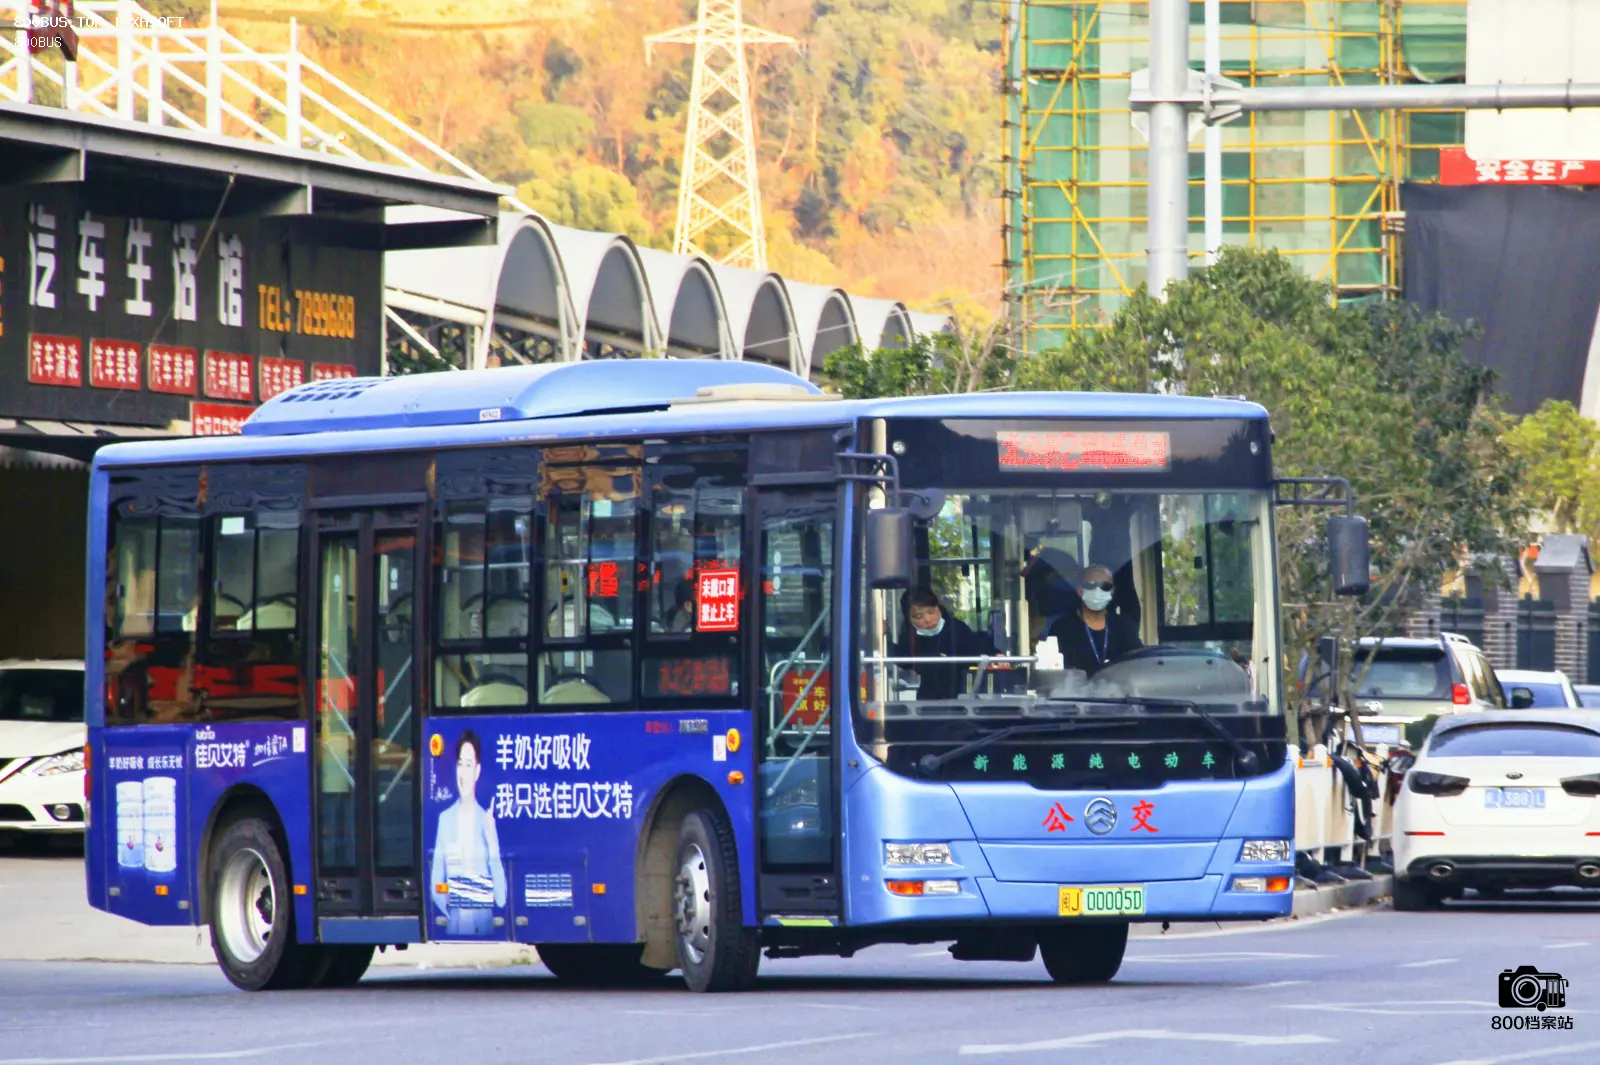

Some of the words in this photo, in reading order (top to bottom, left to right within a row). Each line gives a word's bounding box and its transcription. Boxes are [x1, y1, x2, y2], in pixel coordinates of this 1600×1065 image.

[1475, 160, 1585, 182] 安全生产
[28, 202, 244, 327] 汽车生活馆
[701, 577, 736, 598] 未戴口罩
[701, 602, 735, 623] 禁止上车
[496, 733, 592, 770] 羊奶好吸收
[973, 751, 1216, 772] 新能源纯电动车
[496, 781, 633, 819] 我只选佳贝艾特
